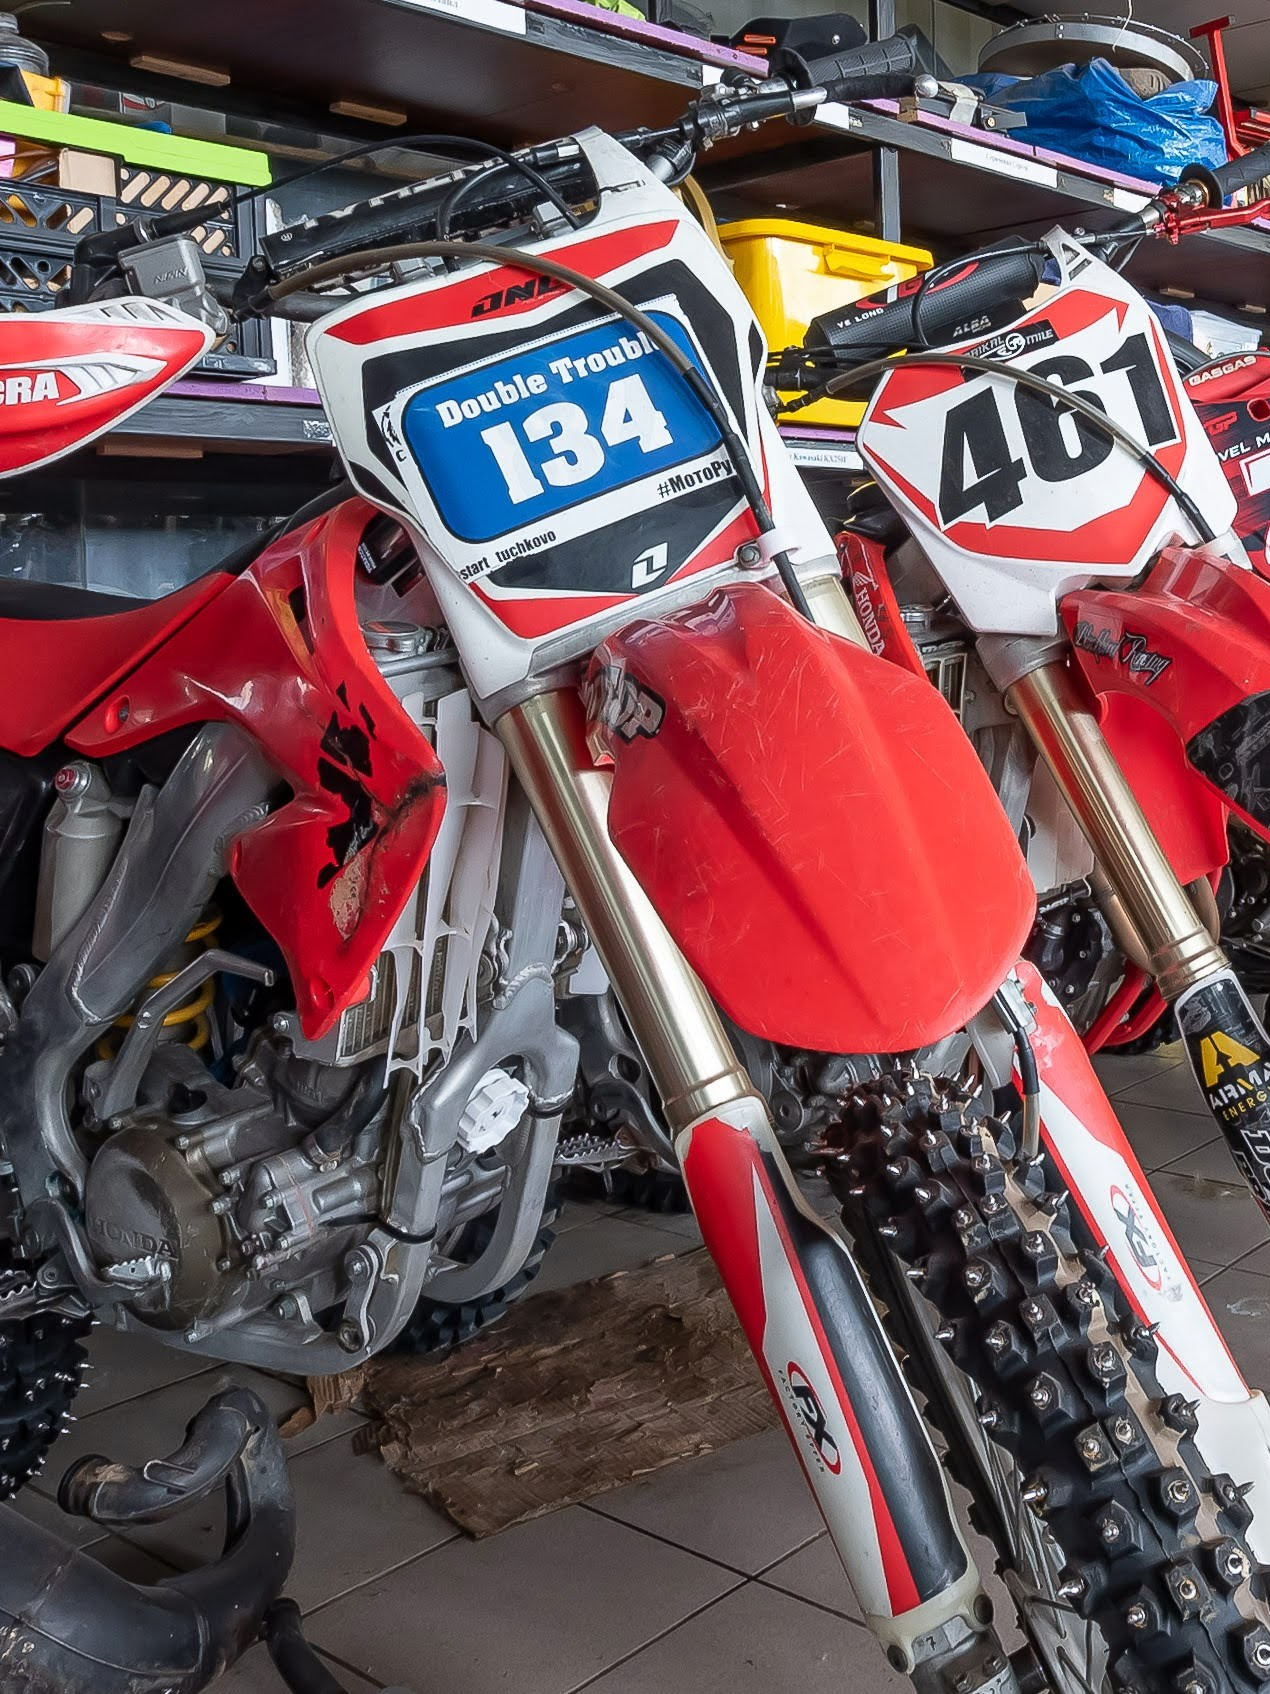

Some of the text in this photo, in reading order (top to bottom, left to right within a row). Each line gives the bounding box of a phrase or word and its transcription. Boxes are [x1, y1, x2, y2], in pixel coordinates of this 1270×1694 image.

[436, 330, 660, 429] Double Troubl
[1189, 355, 1257, 387] GASGAS
[480, 373, 674, 505] 134
[938, 332, 1177, 527] 461
[656, 457, 737, 499] #МотоРу
[856, 586, 886, 656] HONDA
